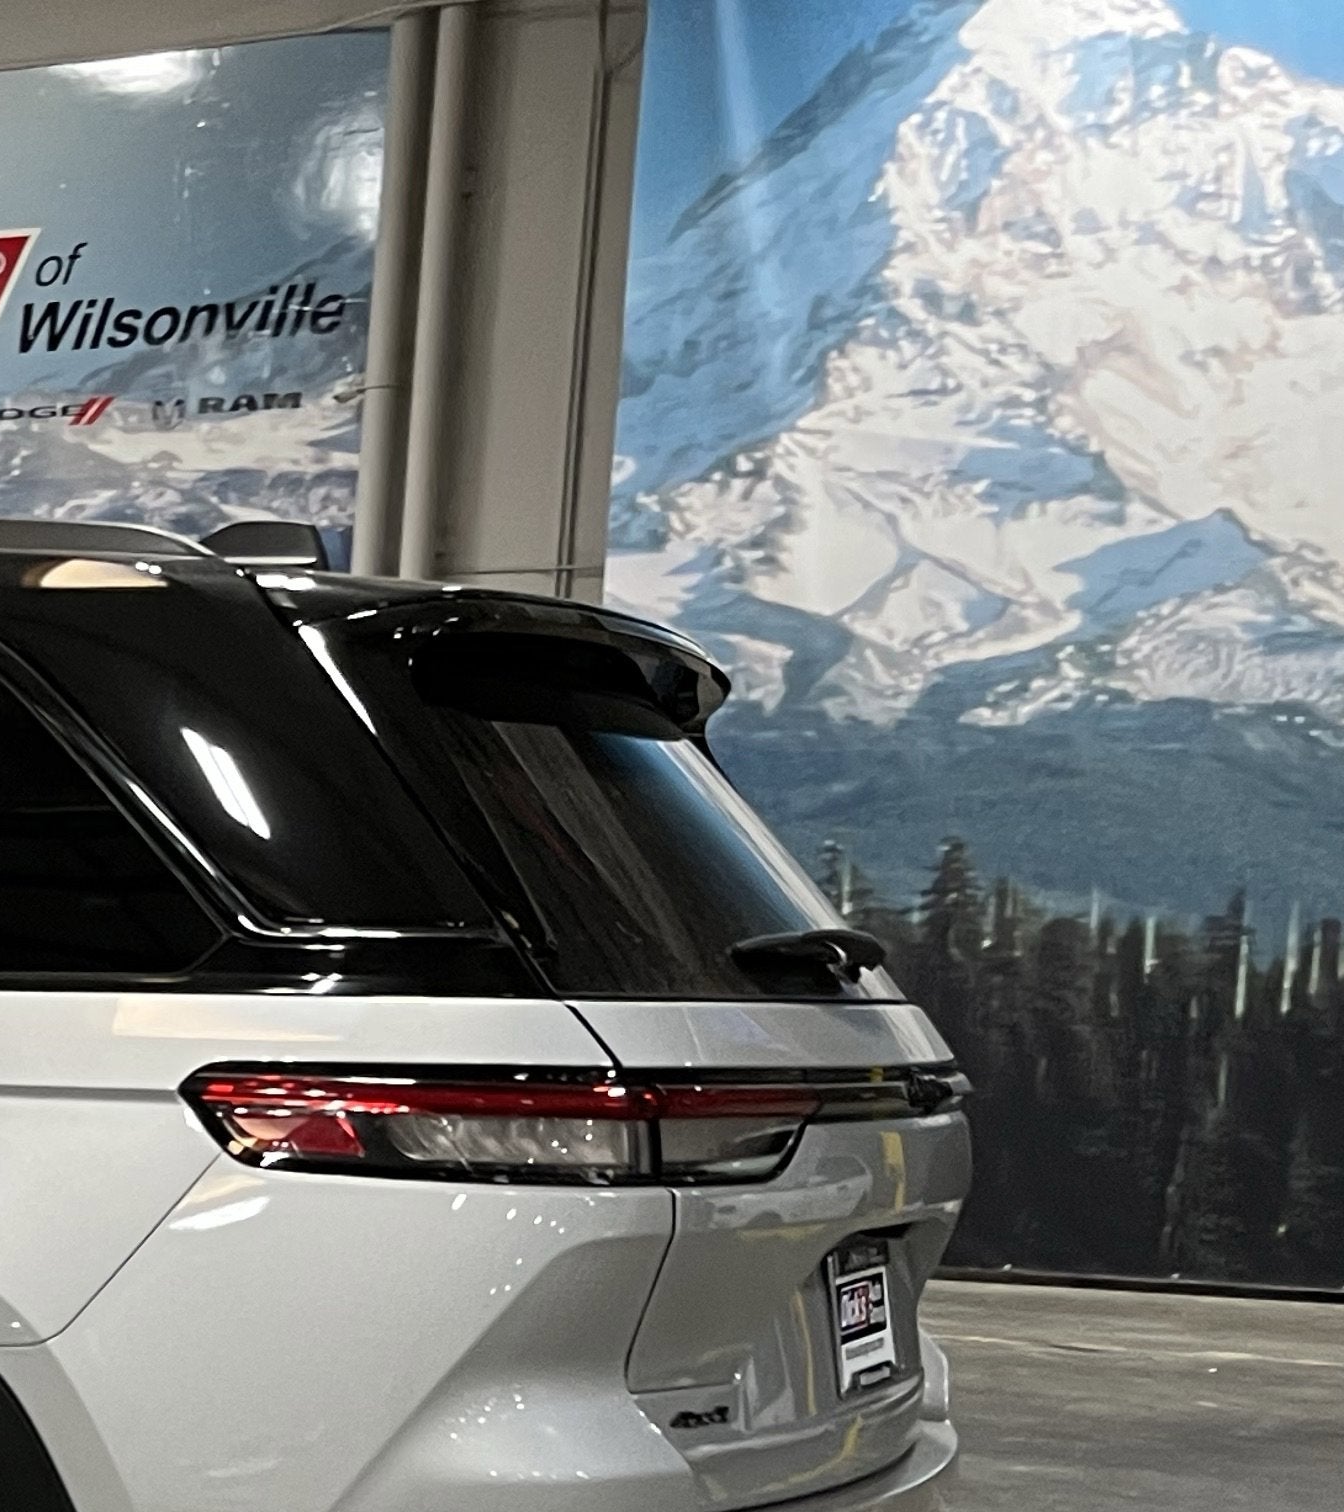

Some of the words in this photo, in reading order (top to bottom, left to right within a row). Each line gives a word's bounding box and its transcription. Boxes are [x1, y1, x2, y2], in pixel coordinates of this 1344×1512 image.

[35, 242, 89, 287] of
[18, 282, 347, 355] Wilsonville
[198, 392, 304, 415] RAM
